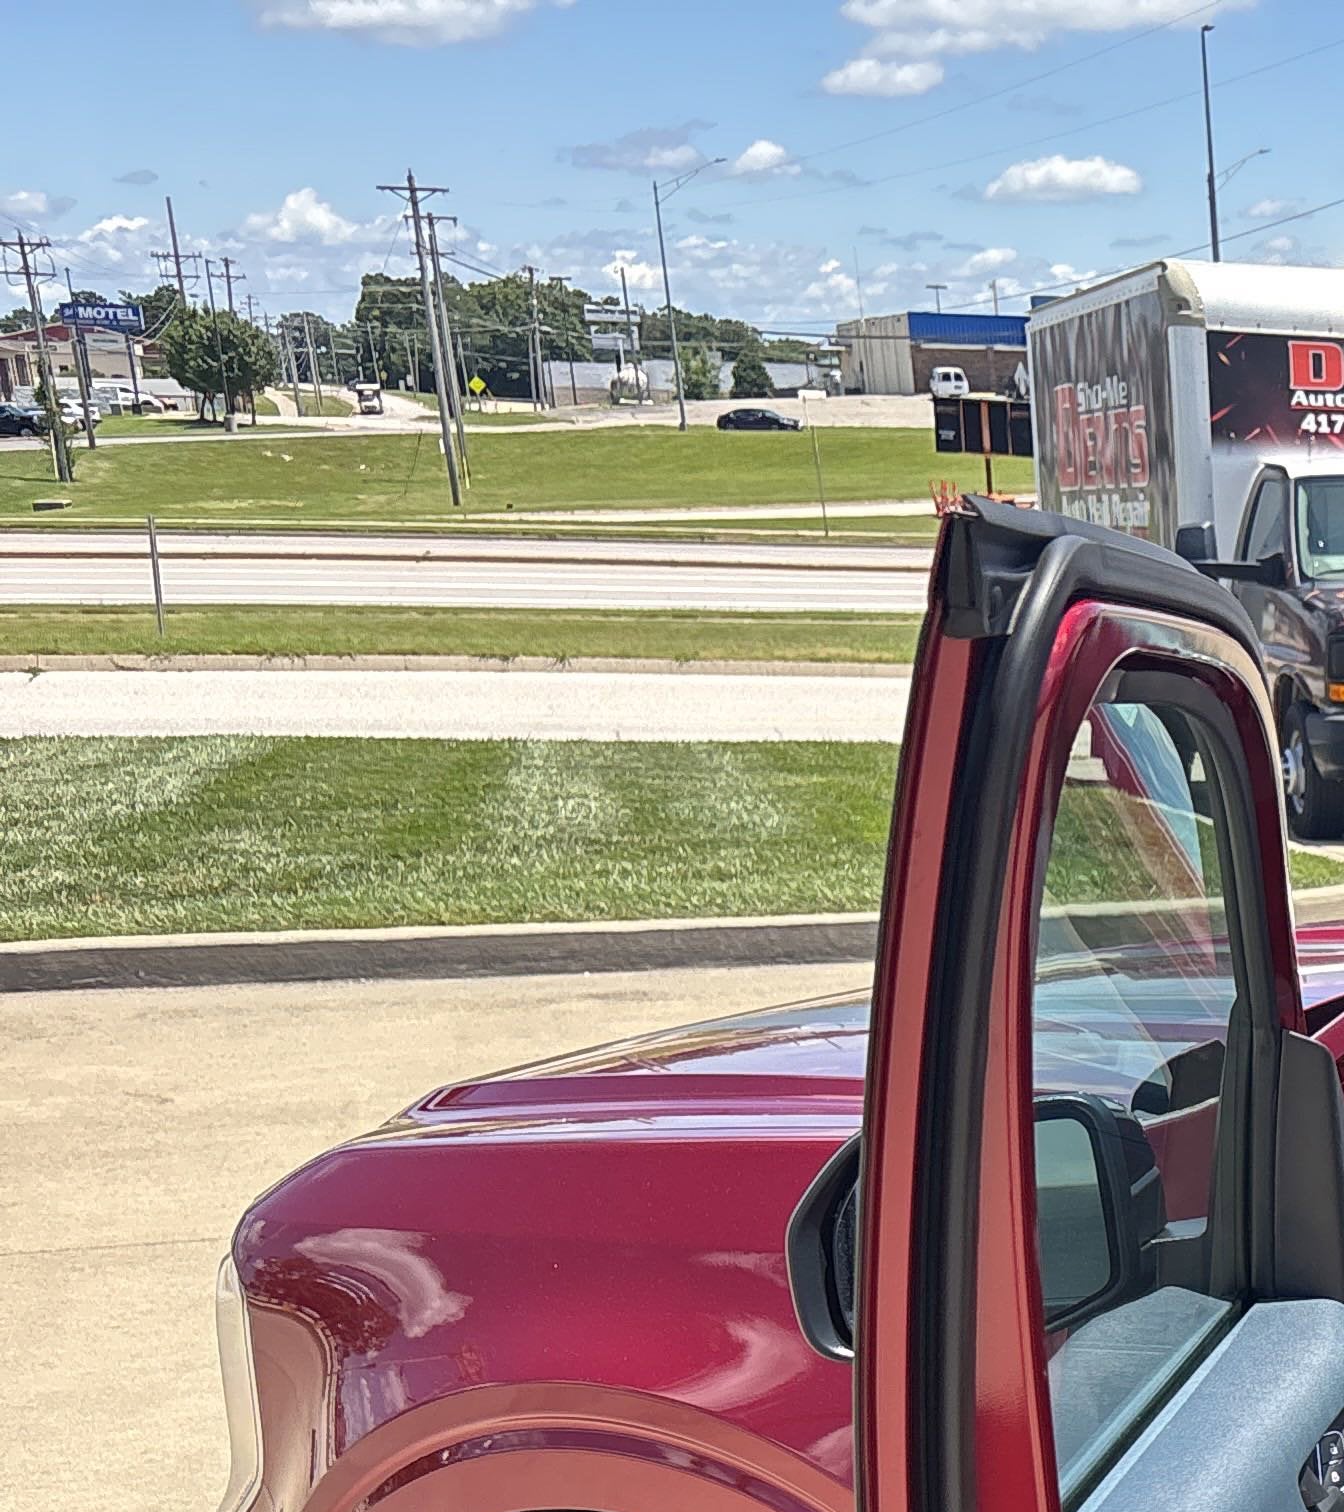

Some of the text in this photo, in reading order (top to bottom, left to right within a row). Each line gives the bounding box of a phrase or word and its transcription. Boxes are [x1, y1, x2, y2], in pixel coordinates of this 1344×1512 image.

[78, 306, 139, 320] MOTEL
[1077, 375, 1128, 412] Sho-Me
[1053, 383, 1149, 491] DENTS
